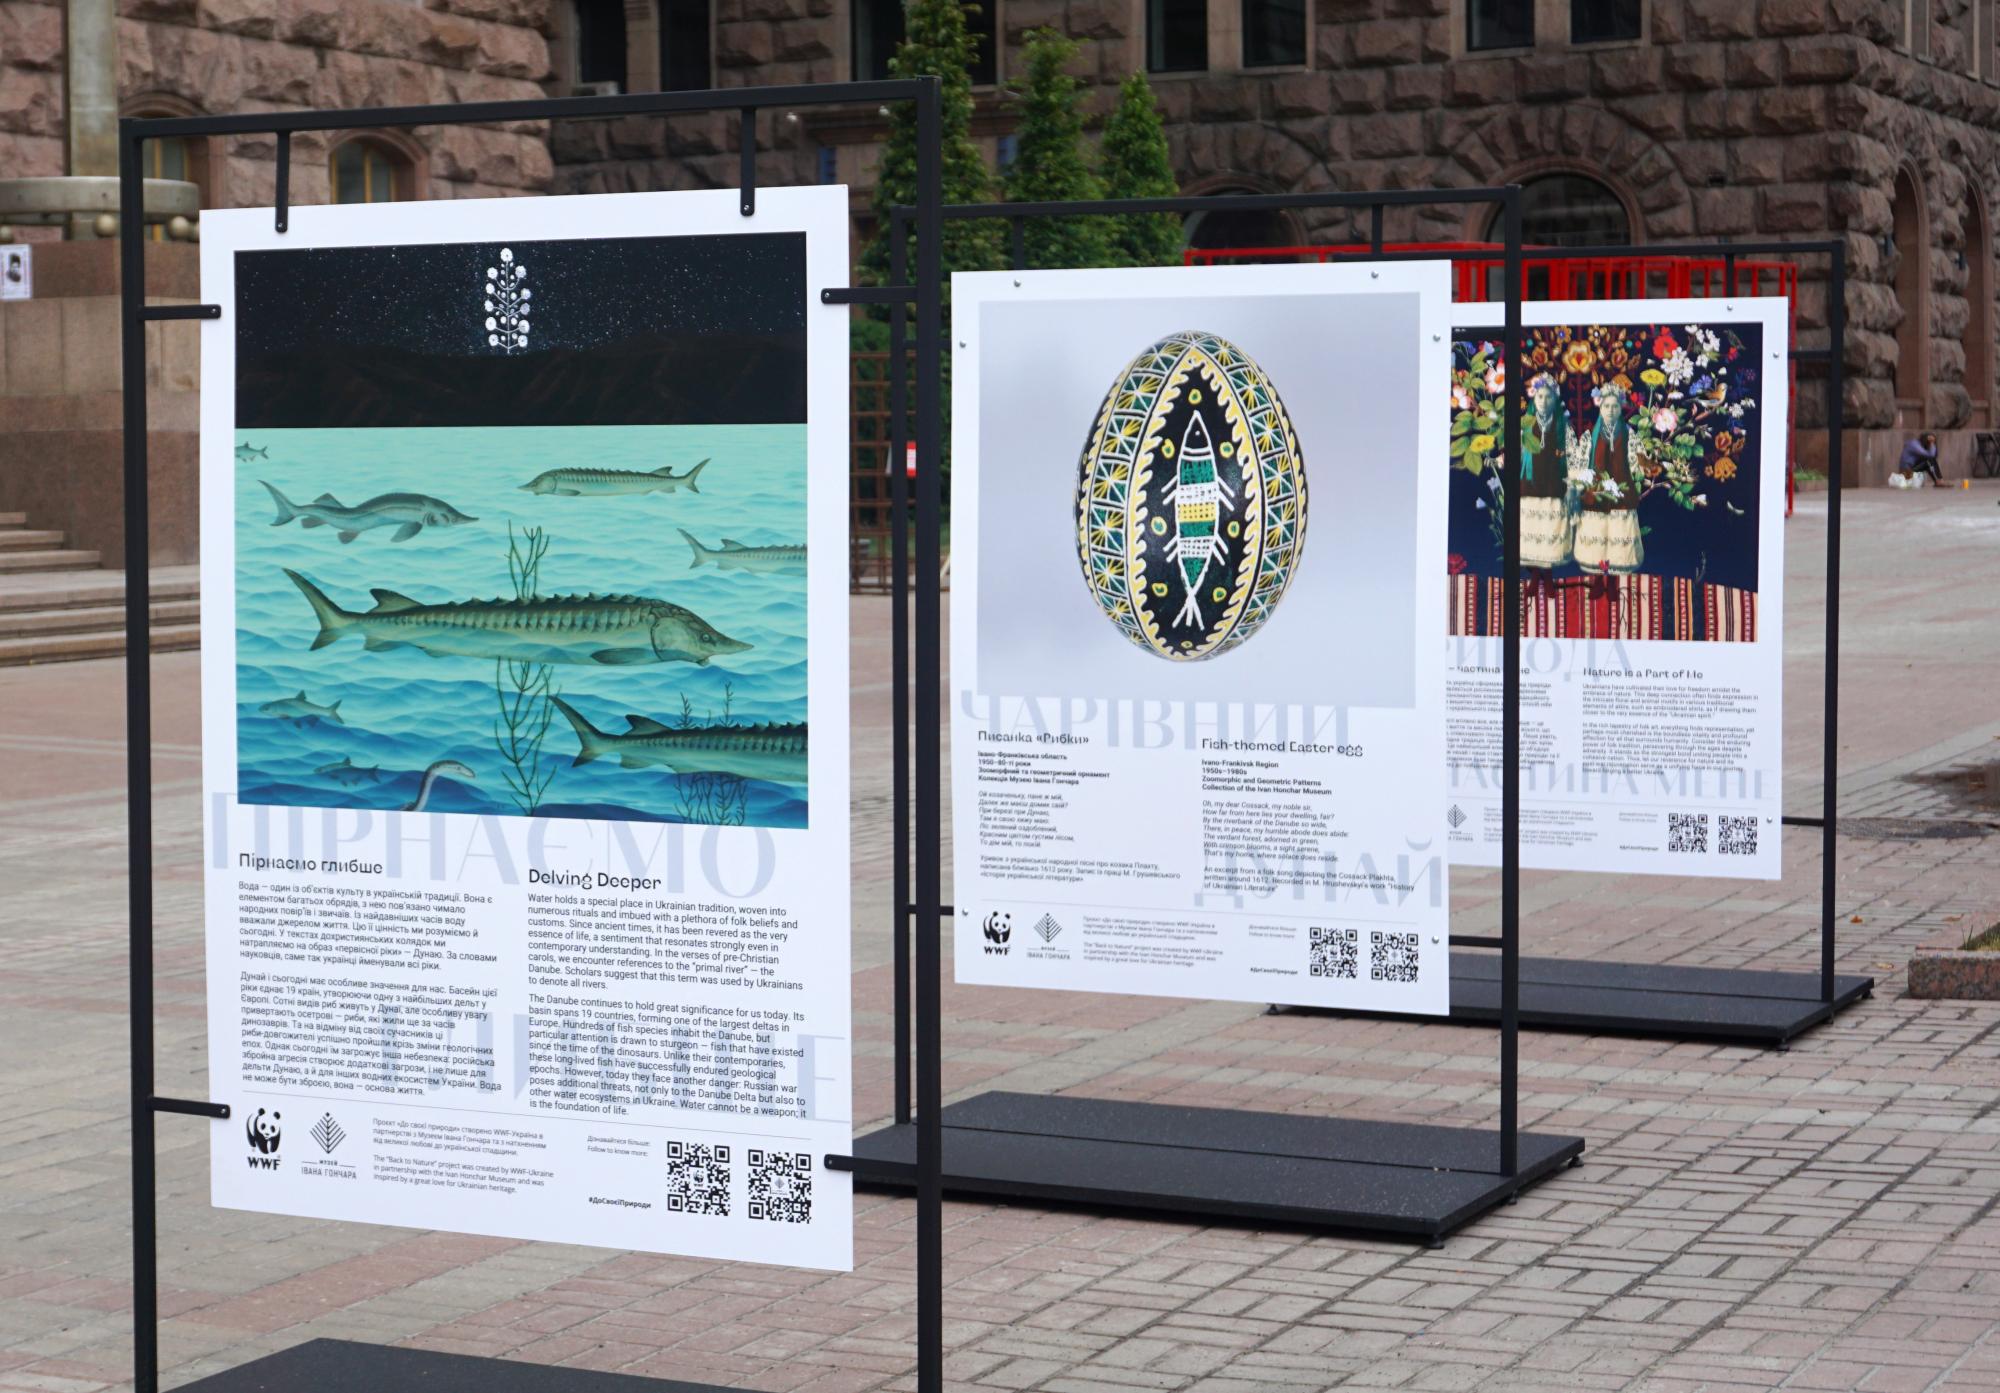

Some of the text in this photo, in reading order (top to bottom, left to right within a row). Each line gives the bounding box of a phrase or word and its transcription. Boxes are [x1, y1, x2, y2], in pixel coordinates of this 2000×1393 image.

[1583, 668, 1622, 677] Nature
[1625, 667, 1633, 677] is
[1636, 669, 1642, 677] a
[1646, 668, 1669, 678] Part
[1672, 669, 1685, 679] of
[978, 730, 1033, 743] Писанка
[1202, 738, 1363, 755] Fish-themed Easter egg
[1201, 758, 1254, 767] Ivano-Frankivsk
[1201, 775, 1241, 783] Zoomorphic
[1256, 777, 1291, 785] Geometric
[1292, 778, 1321, 786] Patterns
[1201, 783, 1235, 791] Collection
[1273, 785, 1302, 793] Honchar
[1302, 787, 1332, 795] Museum
[239, 852, 383, 874] Пірнаємо глибше
[528, 869, 661, 890] Delving Deeper
[239, 881, 259, 891] Вода
[270, 884, 291, 893] один
[292, 884, 300, 892] із
[336, 888, 364, 897] культу
[366, 889, 372, 897] в
[372, 889, 422, 900] українській
[424, 892, 462, 902] традиції.
[463, 893, 486, 903] Вона
[239, 894, 285, 903] елементом
[287, 895, 324, 906] багатьох
[325, 897, 360, 908] обрядів,
[369, 901, 387, 909] нею
[432, 904, 466, 914] чимало
[527, 893, 787, 916] Water holds a special place in Ukrainian tradition, woven into
[527, 906, 798, 929] numerous rituals and imbued with a plethora of folk beliefs and
[527, 917, 788, 941] customs. Since ancient times, it has been revered as the very
[528, 930, 563, 939] essence
[564, 930, 575, 940] of
[576, 931, 592, 942] life,
[600, 933, 643, 944] sentiment
[645, 935, 663, 945] that
[664, 937, 708, 948] resonates
[709, 940, 746, 950] strongly
[747, 943, 769, 952] even
[770, 942, 779, 952] in
[983, 944, 1009, 956] WWF
[528, 941, 779, 965] contemporary understanding. In the verses of pre-Christian
[527, 953, 556, 963] carols,
[557, 953, 571, 963] we
[572, 955, 615, 966] encounter
[617, 957, 663, 969] references
[664, 960, 674, 970] to
[675, 960, 690, 971] the
[759, 965, 775, 976] the
[528, 963, 803, 990] Danube. Scholars suggest that this term was used by Ukrainians
[528, 975, 608, 989] to denote all rivers.
[247, 1153, 279, 1170] WWF
[300, 1166, 357, 1179] ІВАНА ГОНЧАРА
